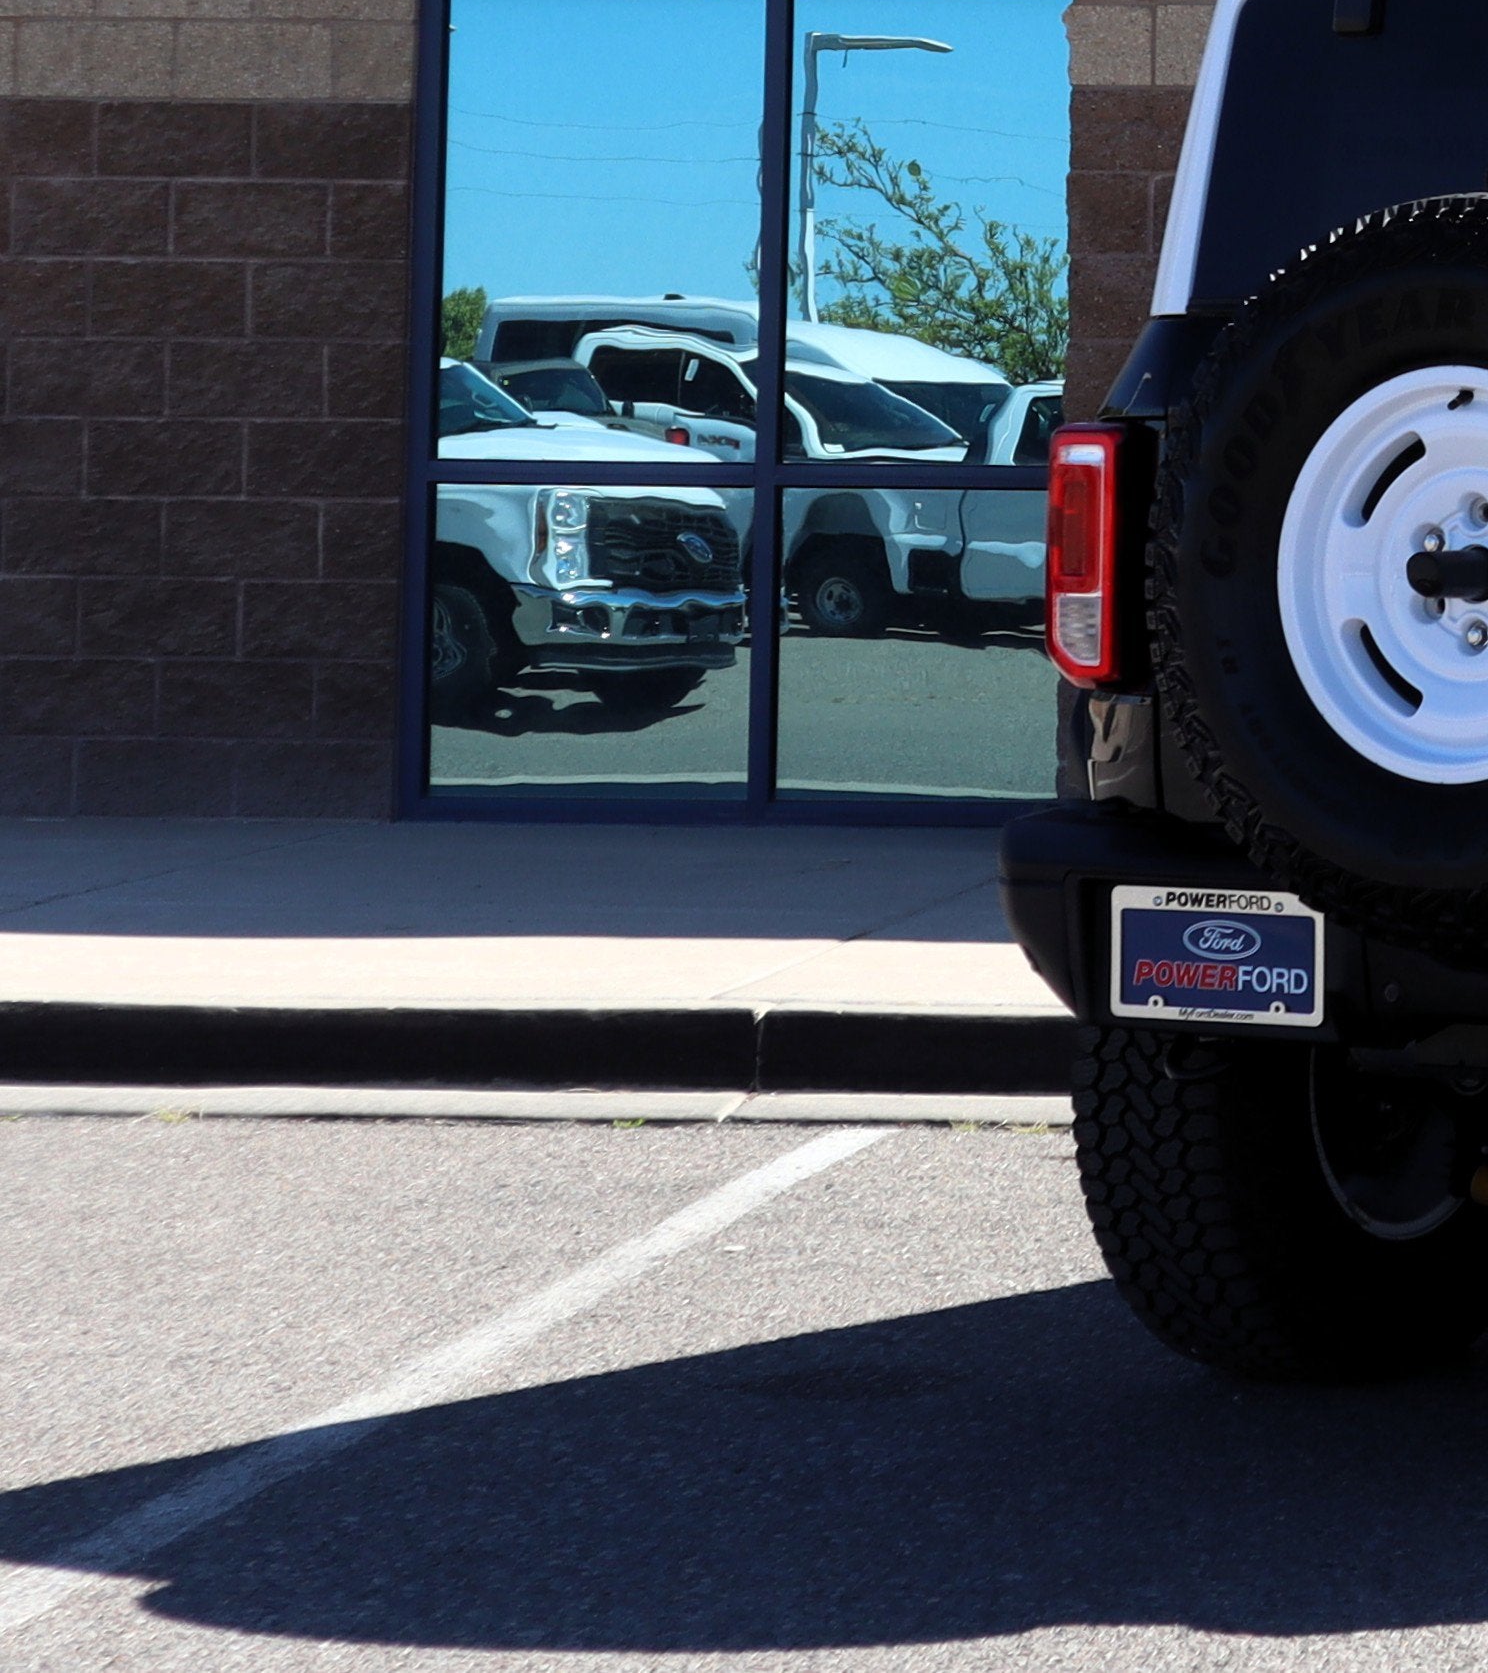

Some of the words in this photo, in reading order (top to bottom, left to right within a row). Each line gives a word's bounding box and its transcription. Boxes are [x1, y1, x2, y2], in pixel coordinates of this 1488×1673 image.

[1165, 891, 1271, 911] POWERFORD
[1199, 926, 1244, 951] Ford
[1133, 959, 1308, 994] POWERFORD
